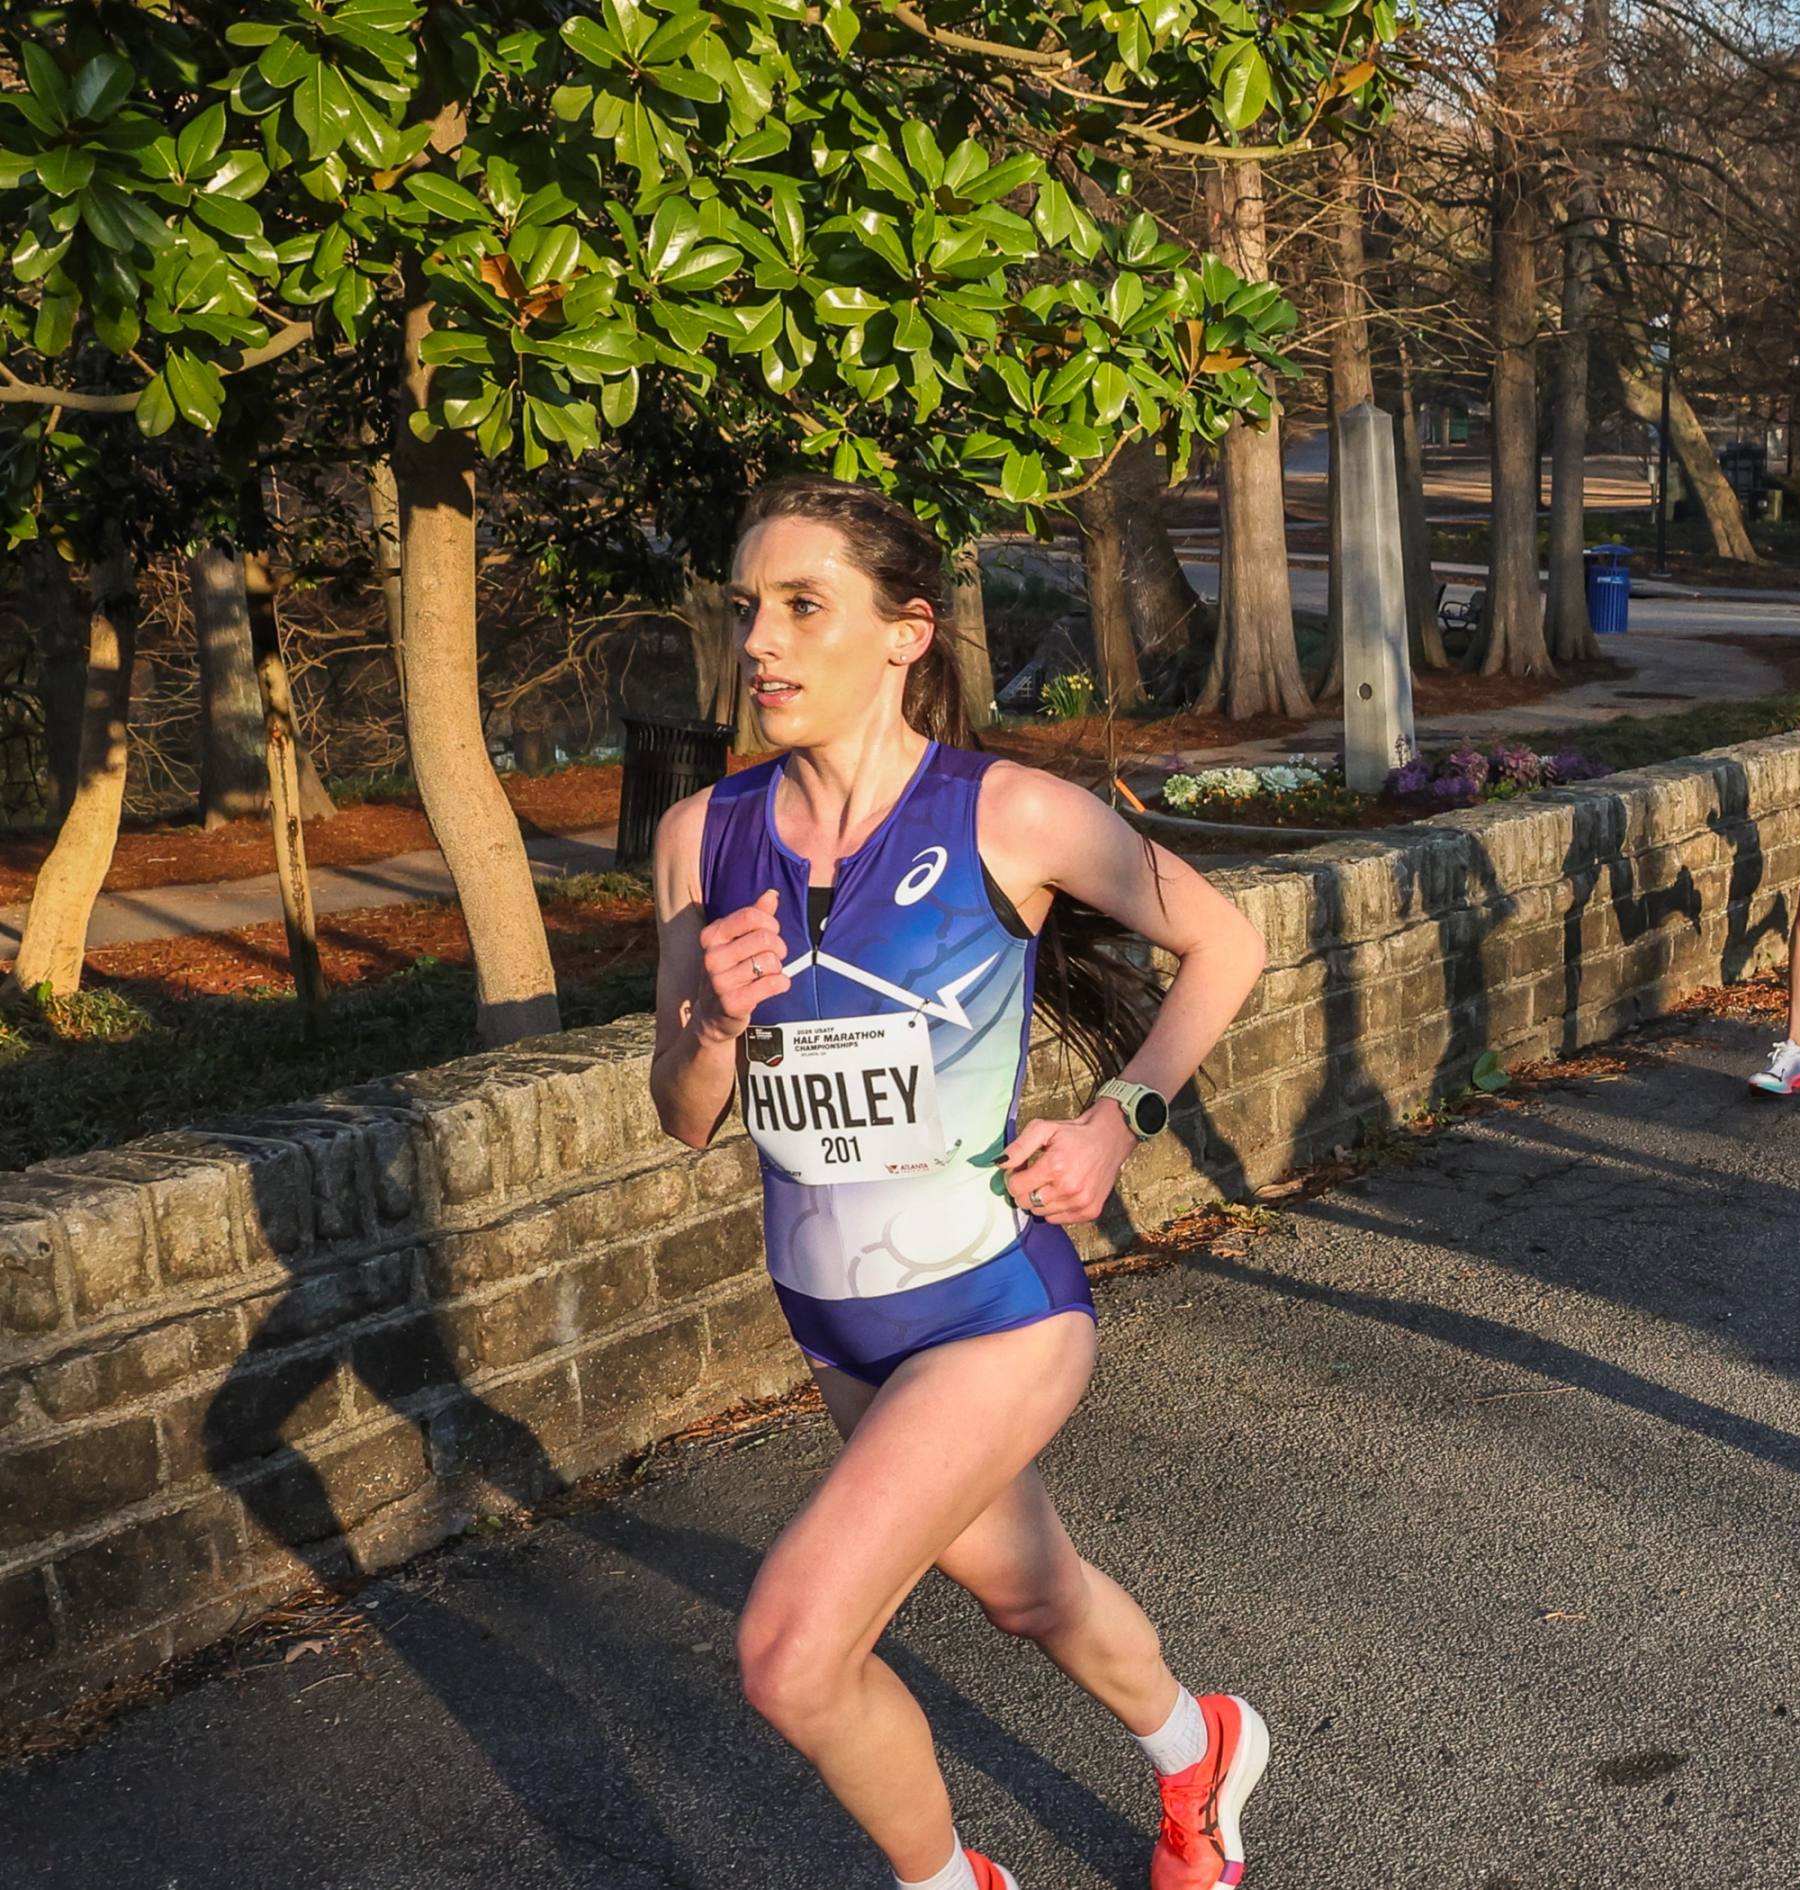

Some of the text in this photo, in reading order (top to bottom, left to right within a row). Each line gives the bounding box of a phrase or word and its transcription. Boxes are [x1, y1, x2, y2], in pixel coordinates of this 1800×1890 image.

[793, 1030, 885, 1045] HALF MARATHON
[794, 1041, 859, 1052] CHAMPIONSHIPS
[750, 1065, 919, 1131] HURLEY
[821, 1136, 861, 1164] 201
